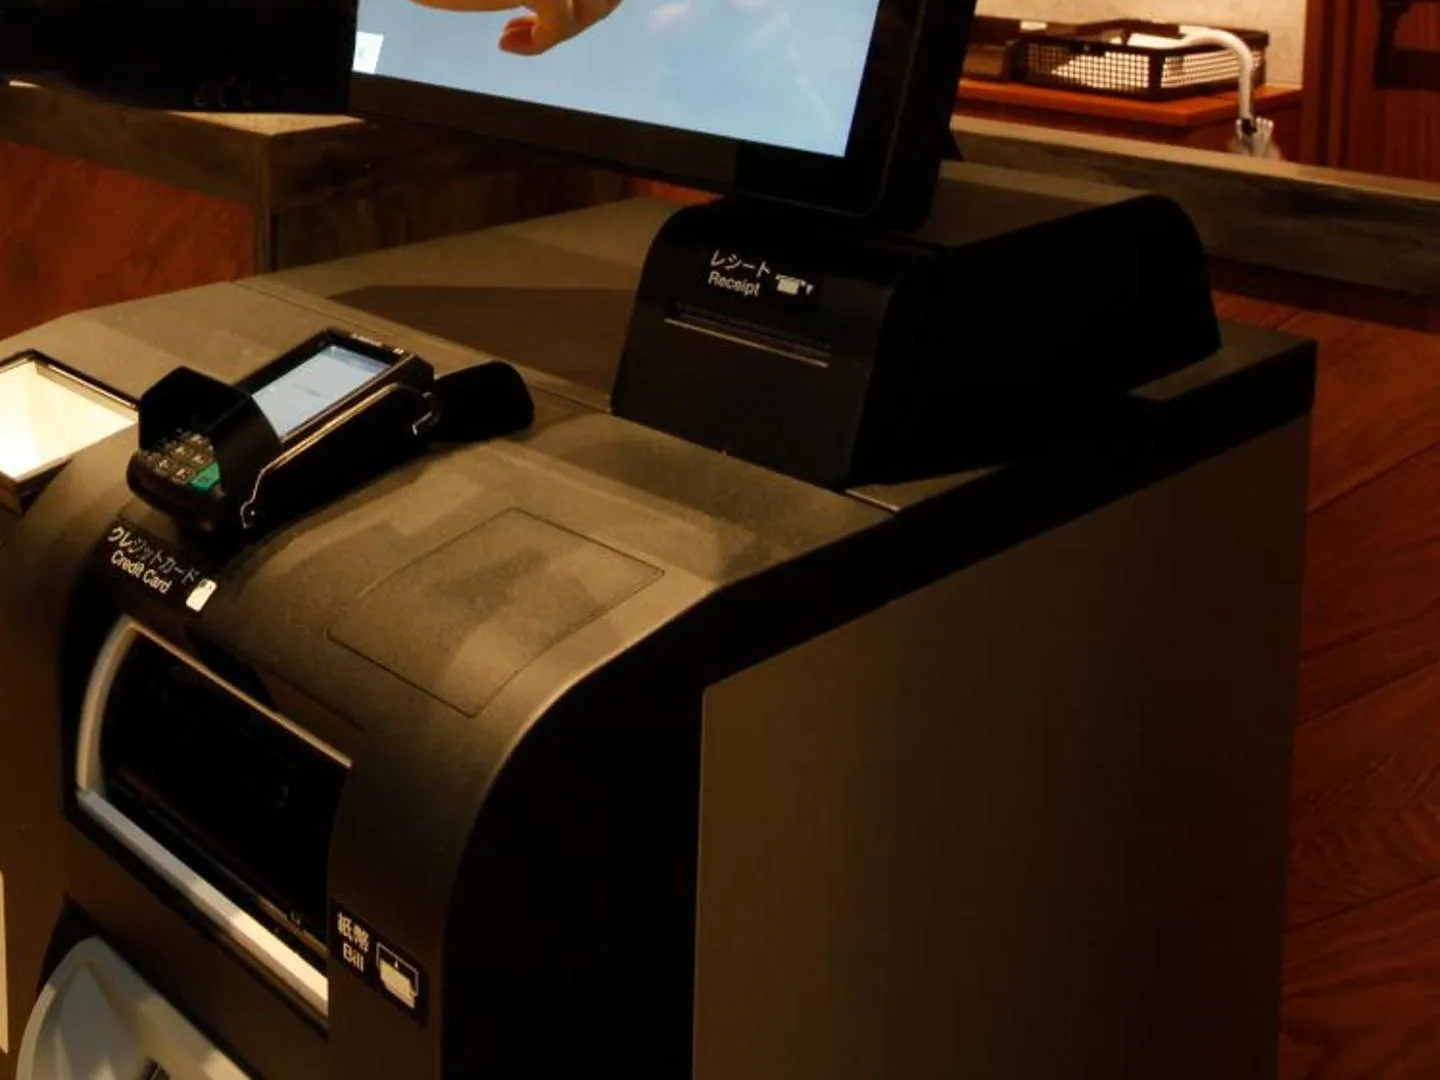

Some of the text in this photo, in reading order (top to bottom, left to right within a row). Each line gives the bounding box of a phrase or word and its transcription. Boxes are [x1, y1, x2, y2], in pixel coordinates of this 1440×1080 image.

[711, 250, 770, 278] レシート
[708, 271, 760, 297] Receipt
[108, 526, 200, 585] クレジットカード
[111, 549, 173, 594] Credit Card
[343, 941, 364, 973] Bill
